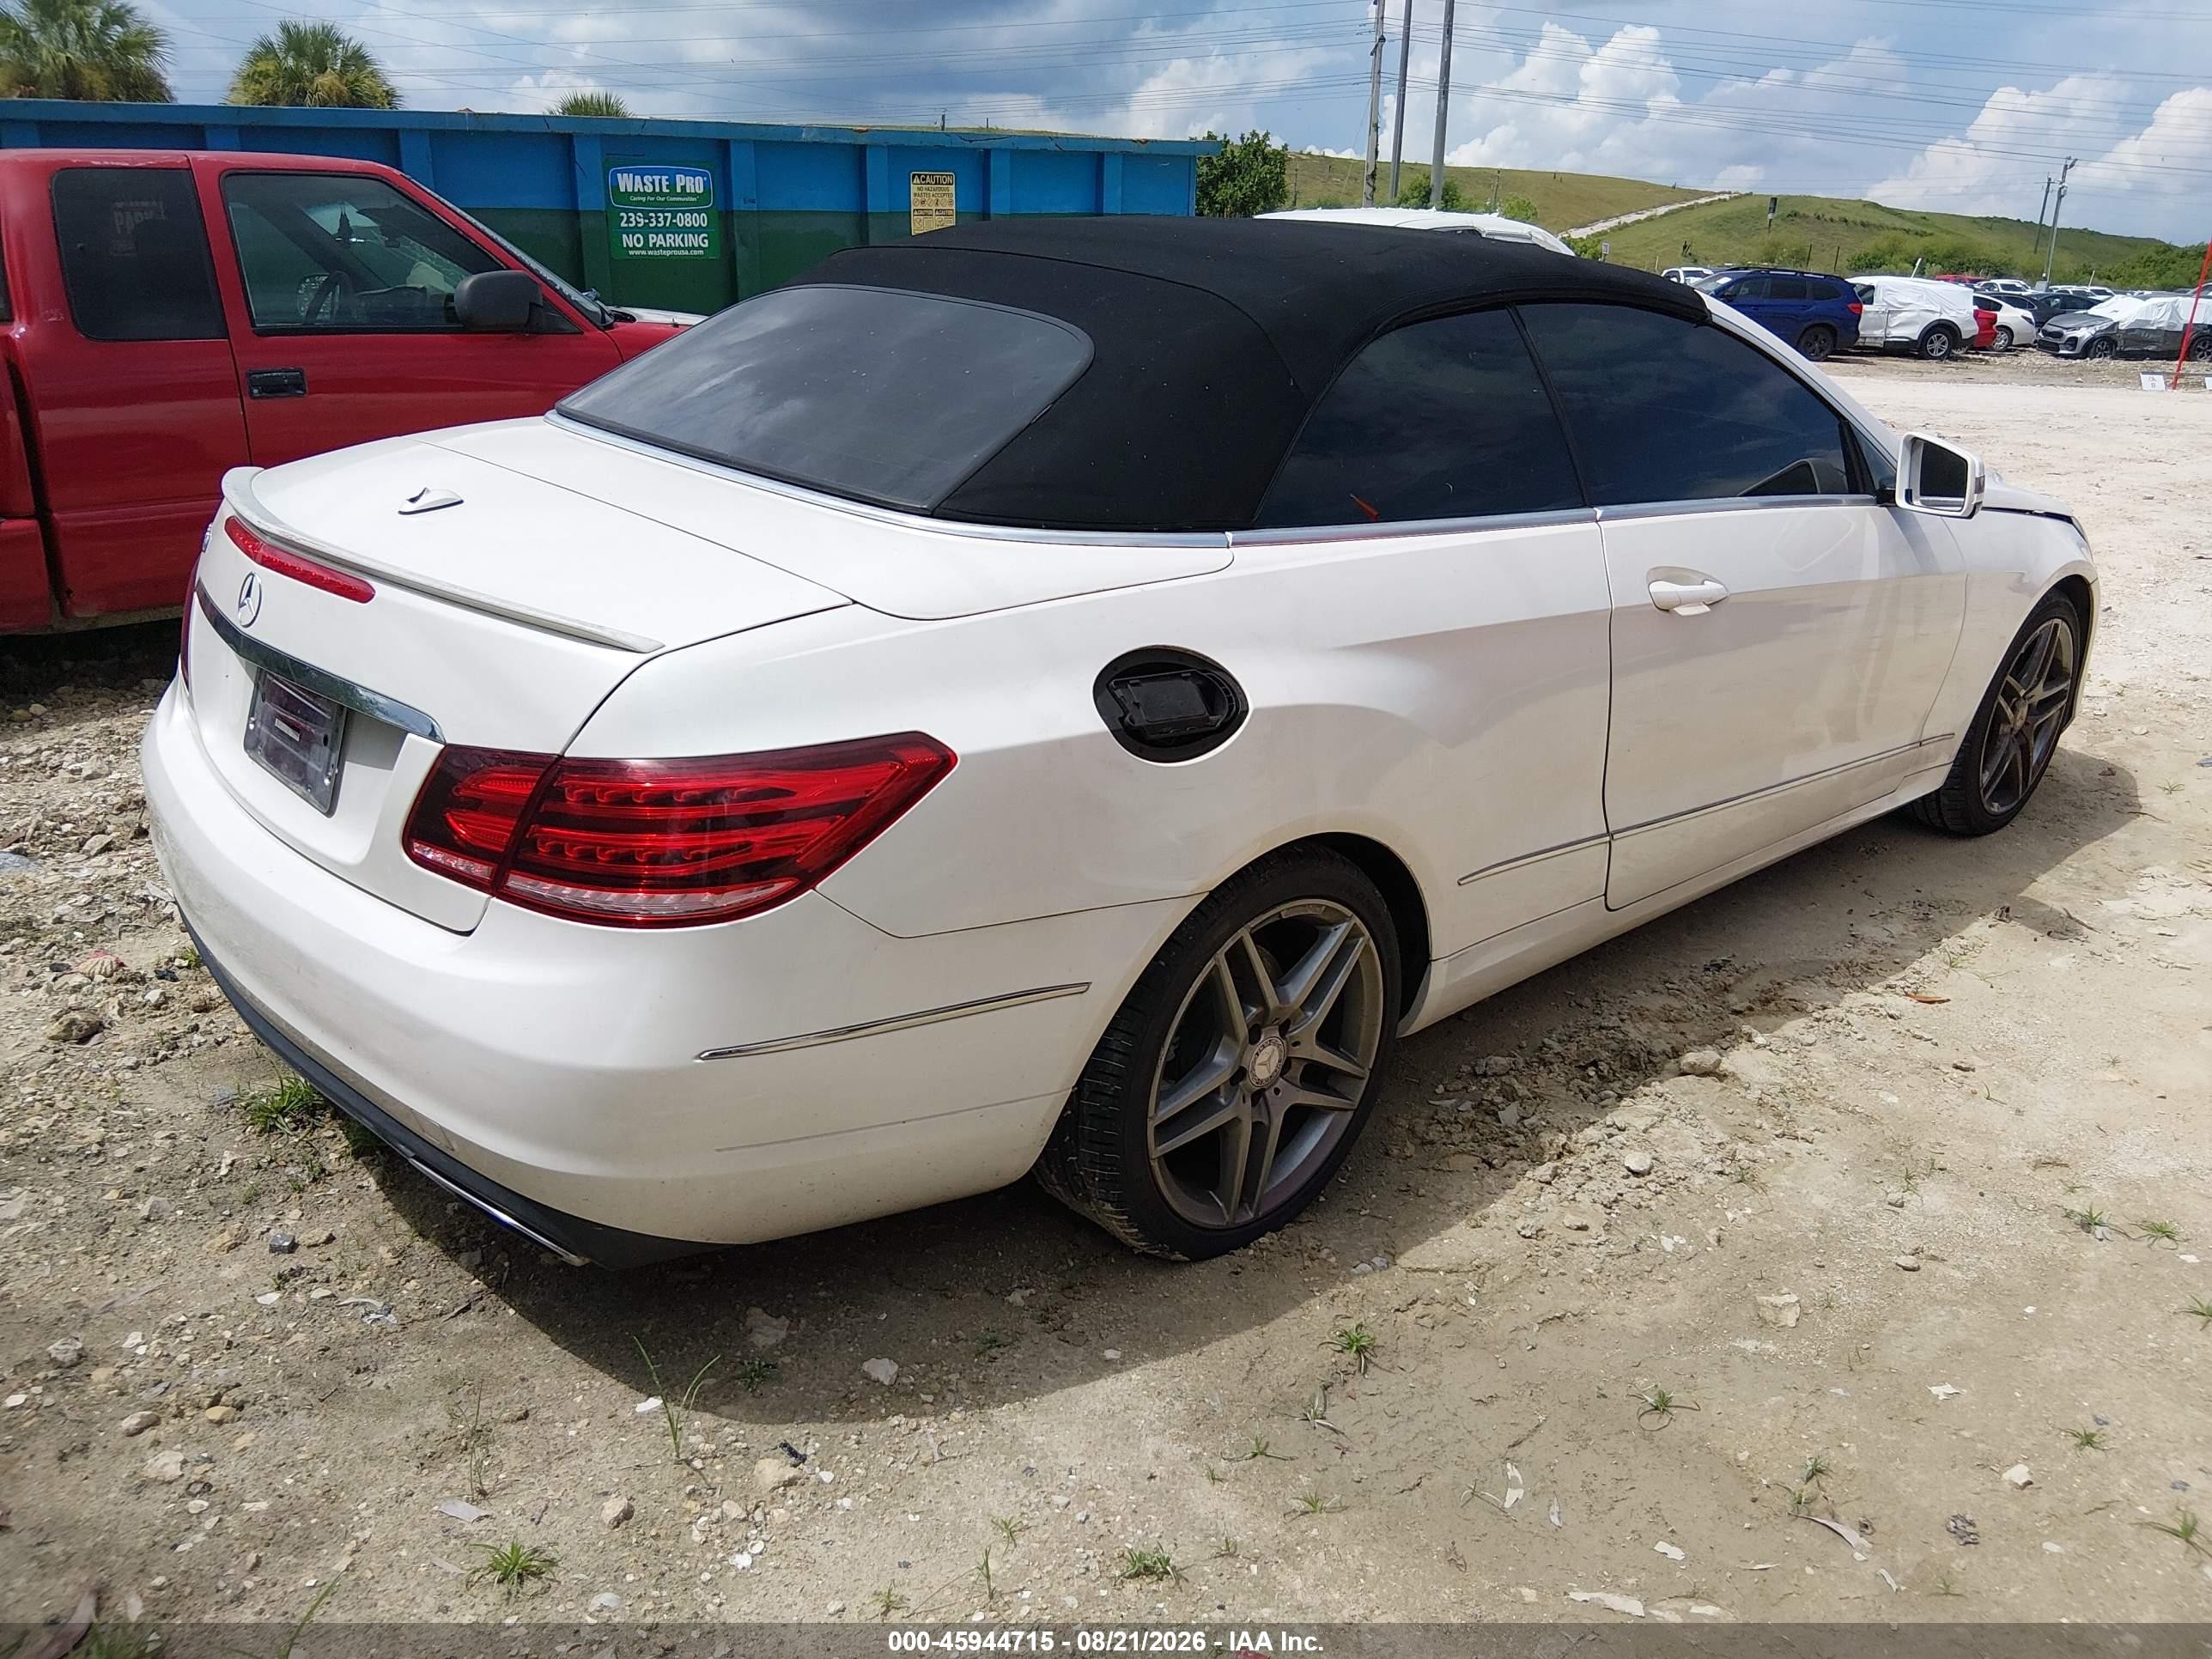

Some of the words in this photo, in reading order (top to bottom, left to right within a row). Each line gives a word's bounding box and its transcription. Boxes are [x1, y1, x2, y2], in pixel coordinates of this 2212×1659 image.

[617, 173, 670, 192] WASTE
[676, 174, 704, 193] PRO
[920, 174, 952, 184] CAUTION
[619, 212, 708, 228] 239-337-0800
[623, 234, 644, 247] NO
[648, 234, 709, 248] PARKING
